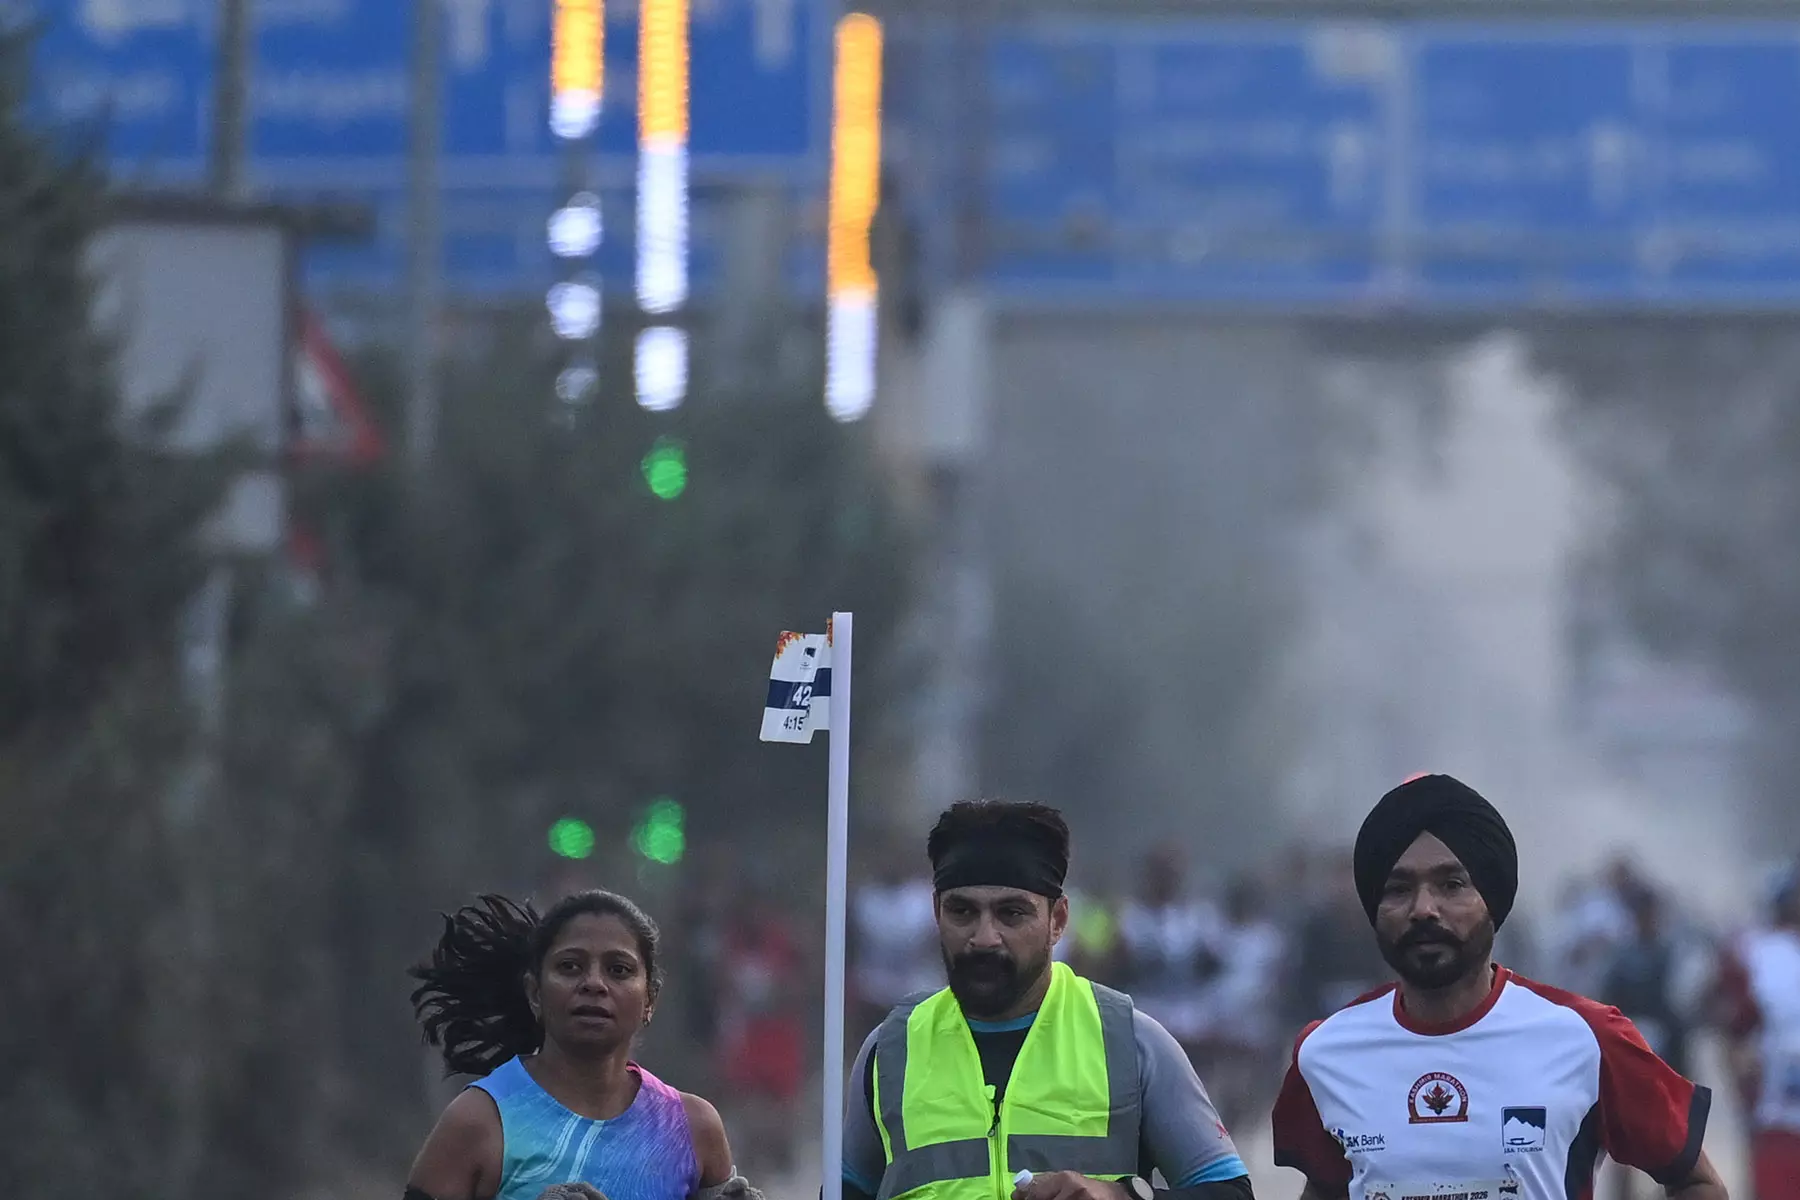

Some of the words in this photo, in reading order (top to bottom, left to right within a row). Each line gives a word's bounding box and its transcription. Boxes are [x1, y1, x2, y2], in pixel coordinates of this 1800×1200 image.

[1433, 1072, 1468, 1103] MARATHON
[1361, 1133, 1385, 1146] Bank
[1469, 1190, 1488, 1200] 2026
